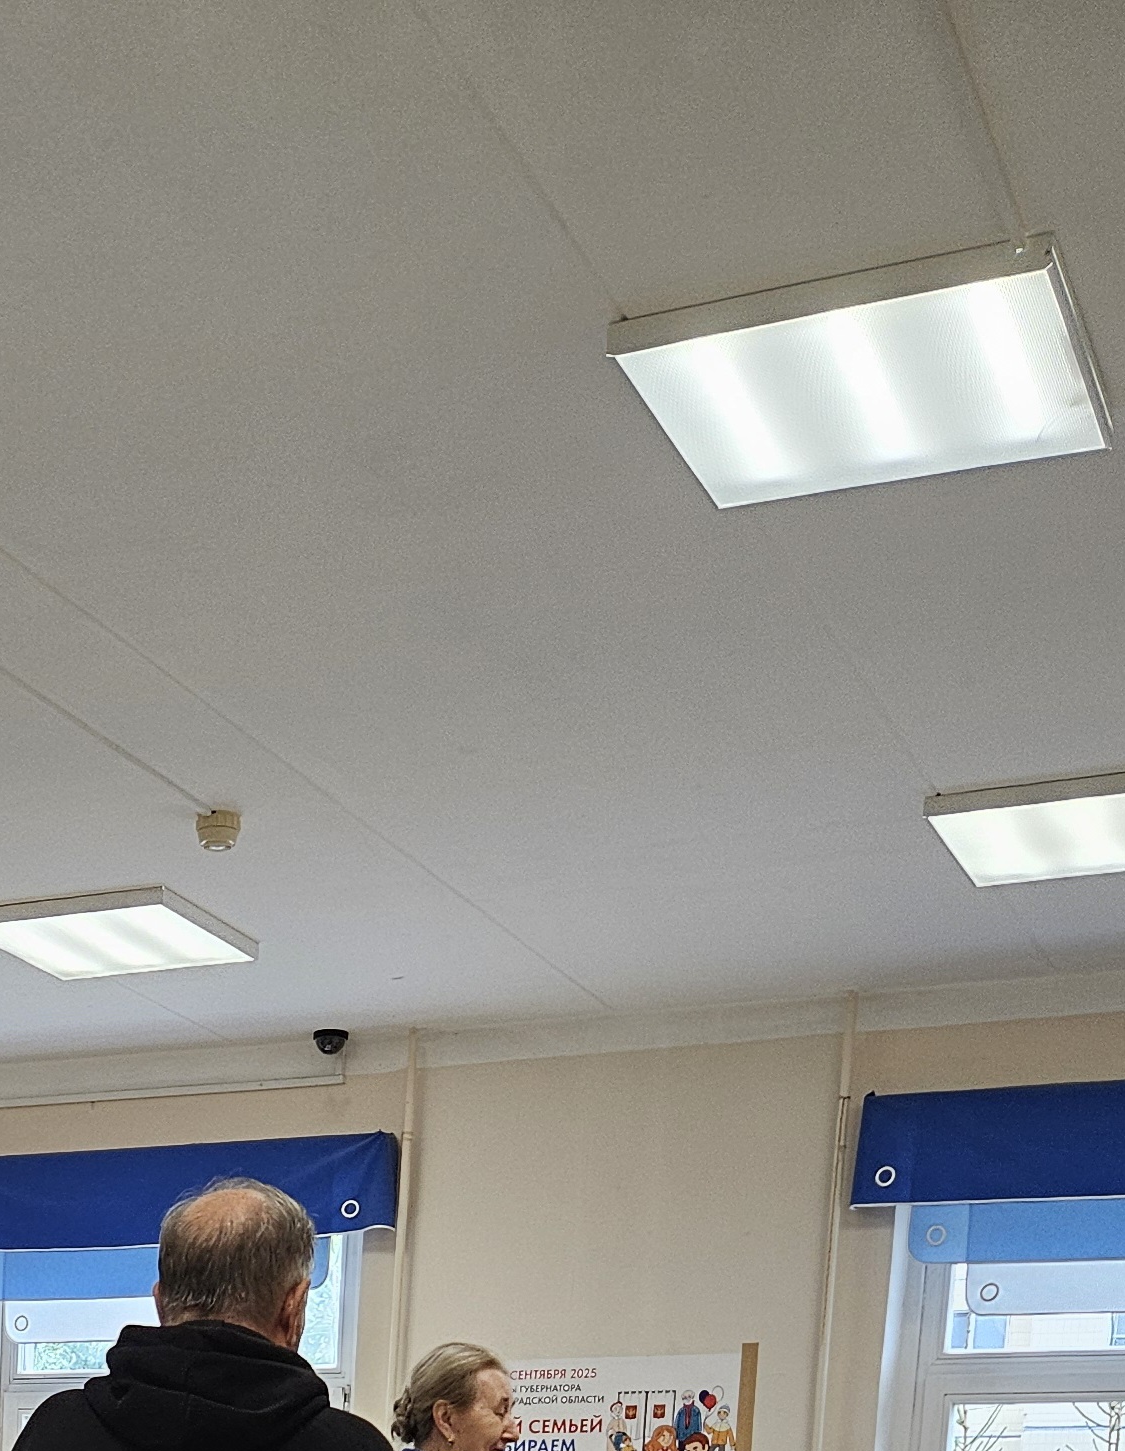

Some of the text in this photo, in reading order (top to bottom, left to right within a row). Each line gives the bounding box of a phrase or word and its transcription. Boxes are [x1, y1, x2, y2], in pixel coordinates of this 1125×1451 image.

[510, 1368, 597, 1380] СЕНТЯБРЯ 2025
[519, 1384, 581, 1393] ГУБЕРНАТОРА
[514, 1395, 605, 1406] РАДСКОЙ ОБЛАСТИ
[529, 1414, 603, 1434] СЕМЬЕЙ
